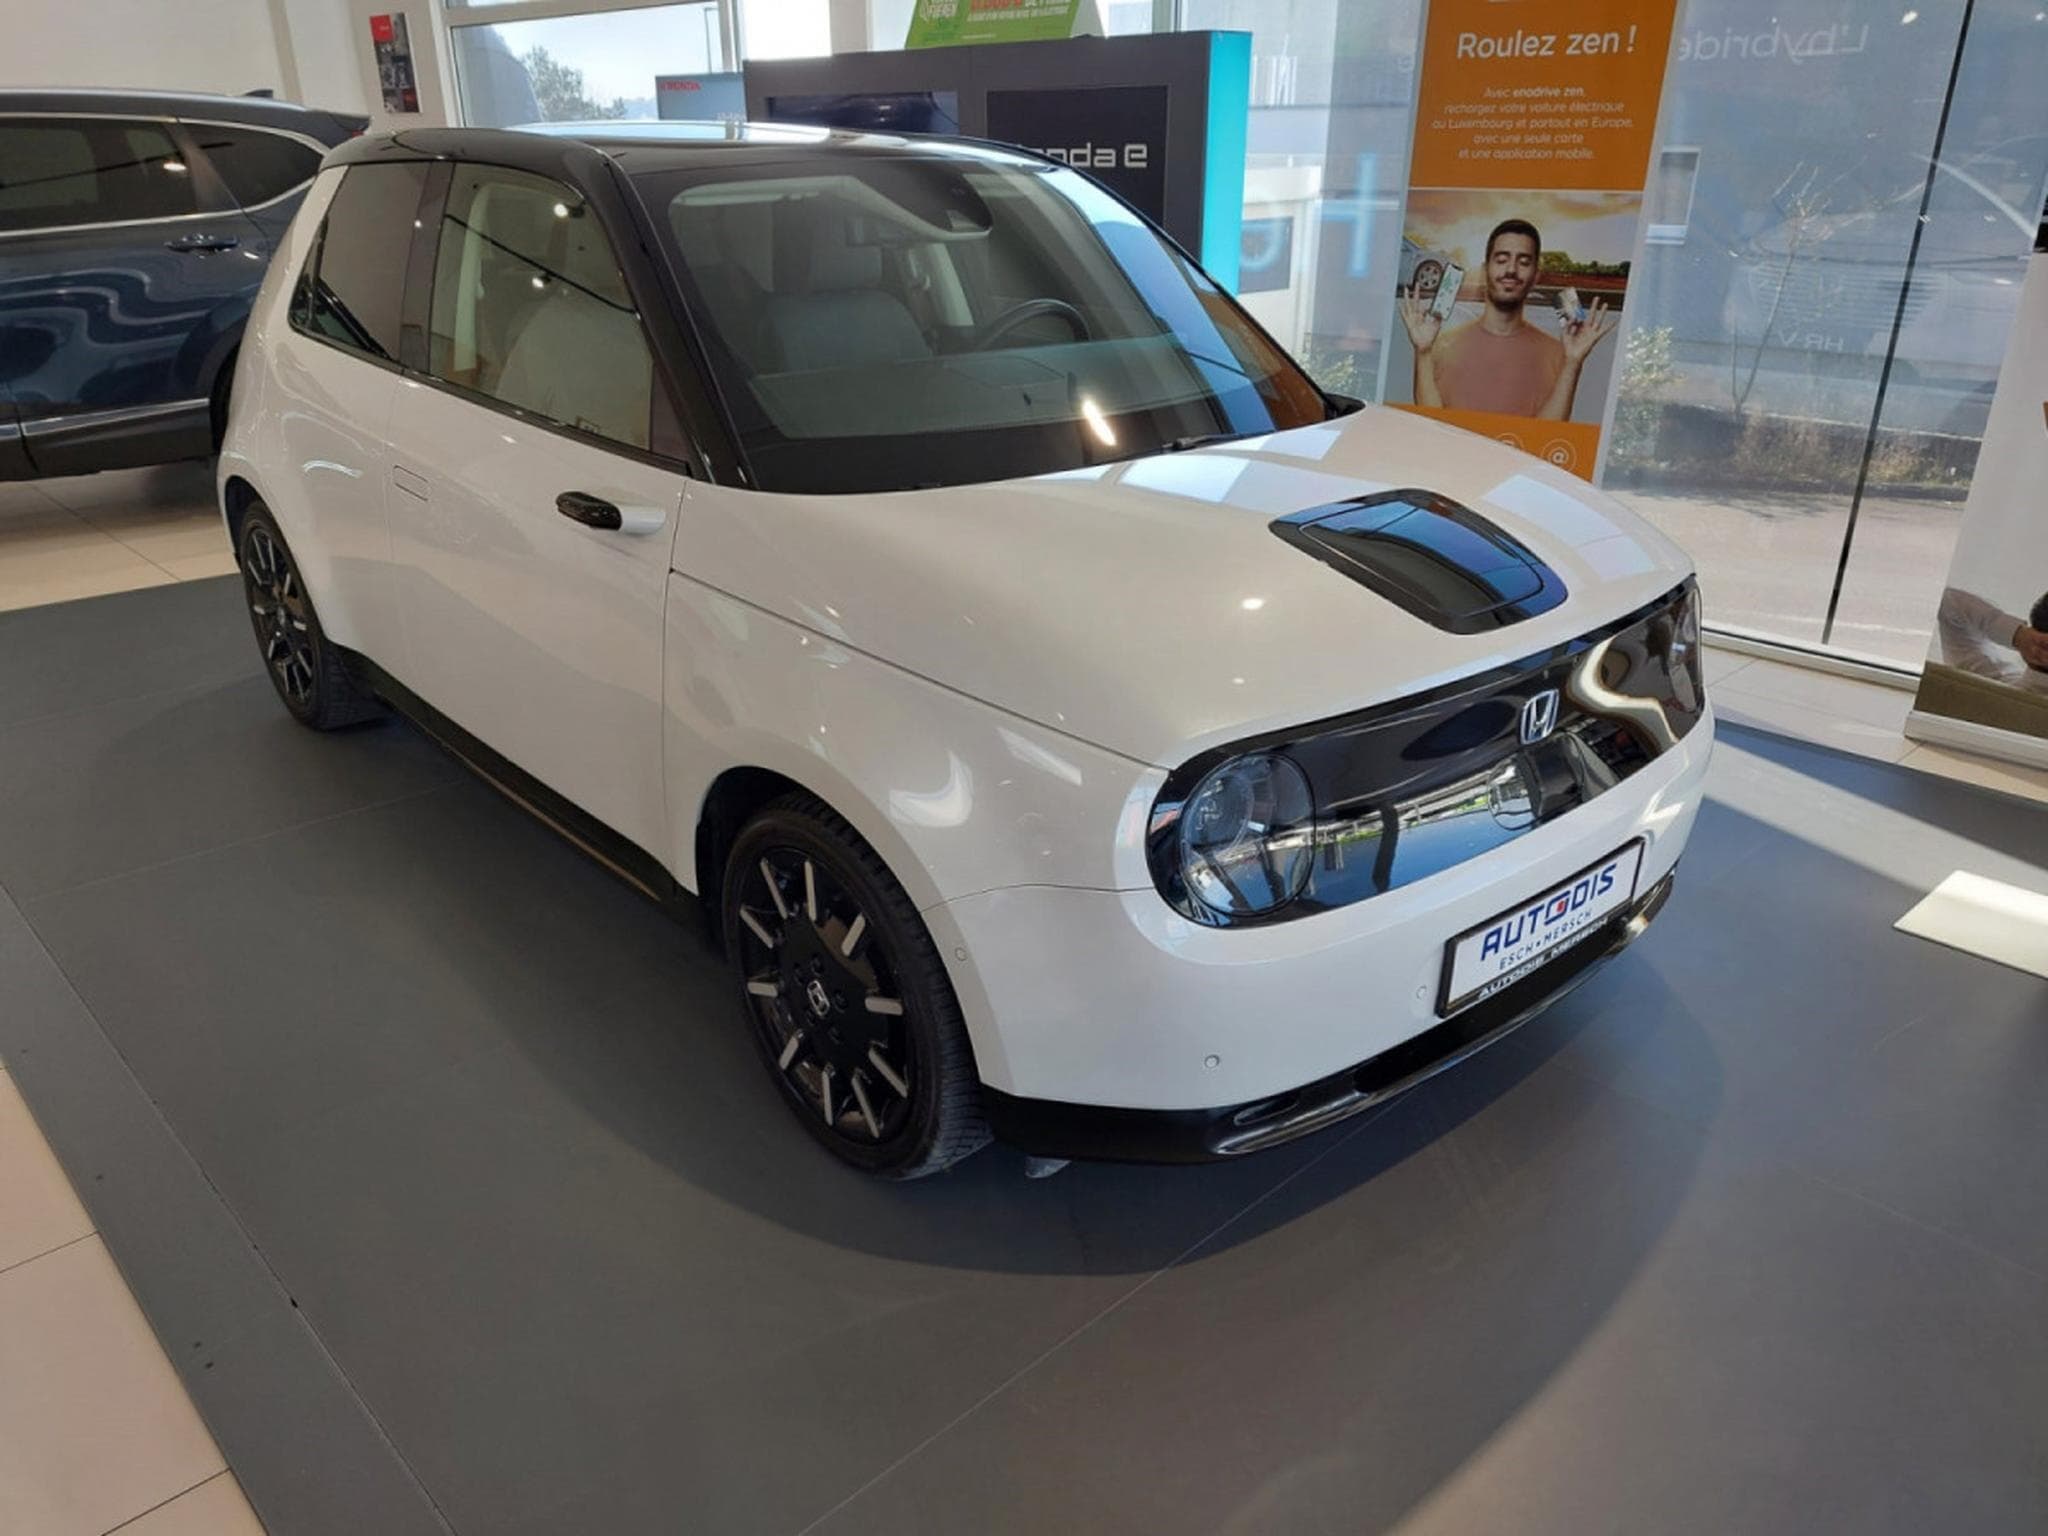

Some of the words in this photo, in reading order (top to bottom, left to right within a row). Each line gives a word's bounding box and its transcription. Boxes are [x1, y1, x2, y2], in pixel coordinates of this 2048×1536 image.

[1456, 30, 1557, 60] Roulez
[1565, 31, 1621, 56] zen
[1484, 87, 1511, 98] Avec
[1513, 86, 1561, 97] enodrive
[1500, 104, 1527, 113] votre
[1529, 103, 1567, 113] voiture
[1448, 118, 1514, 131] Luxembourg
[1516, 119, 1528, 128] et
[1530, 118, 1572, 129] partout
[1574, 119, 1588, 128] en
[1473, 134, 1499, 144] avec
[1501, 135, 1520, 143] une
[1523, 133, 1551, 143] seule
[1554, 133, 1585, 143] carte
[1458, 148, 1470, 159] et
[1471, 149, 1491, 159] une
[1492, 148, 1554, 161] application
[1480, 862, 1617, 962] AUTODIS
[1542, 910, 1592, 945] MERSCH
